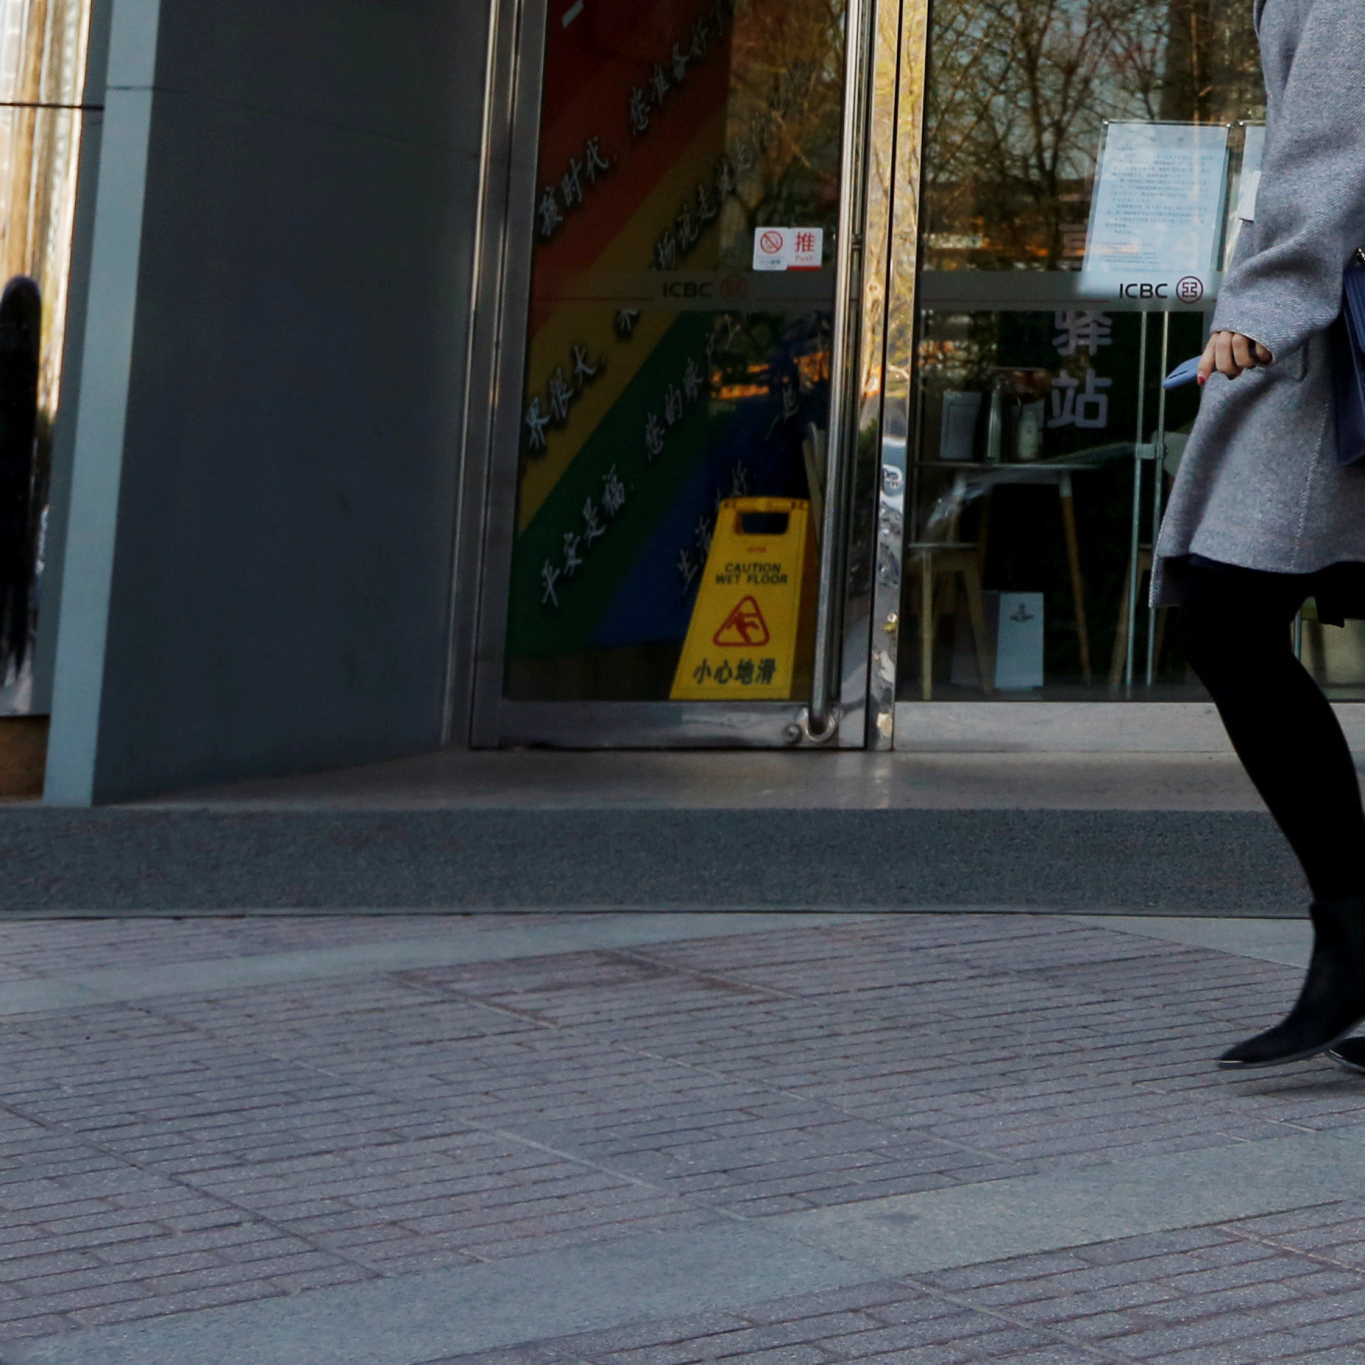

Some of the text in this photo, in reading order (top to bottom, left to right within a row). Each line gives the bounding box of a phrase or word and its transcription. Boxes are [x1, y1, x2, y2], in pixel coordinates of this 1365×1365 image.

[795, 231, 815, 252] 推
[662, 281, 713, 299] ICBC
[1118, 283, 1169, 300] ICBC
[724, 562, 782, 574] CAUTION
[716, 573, 788, 585] WET FLOOR
[693, 657, 776, 685] 小心地滑
